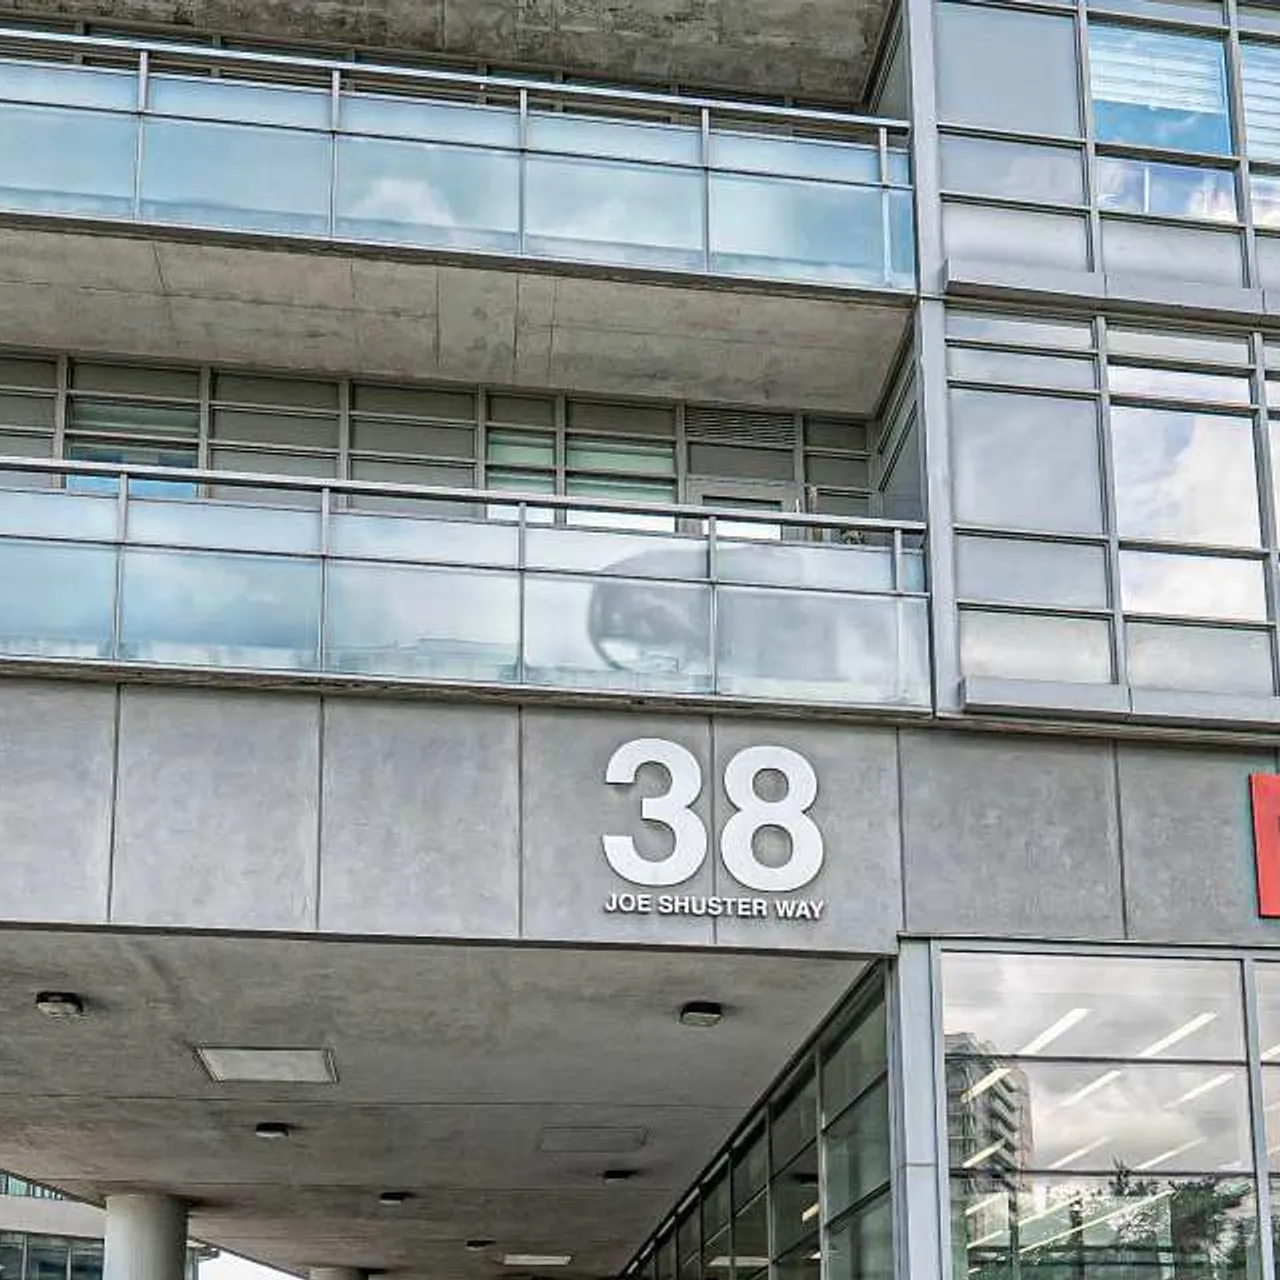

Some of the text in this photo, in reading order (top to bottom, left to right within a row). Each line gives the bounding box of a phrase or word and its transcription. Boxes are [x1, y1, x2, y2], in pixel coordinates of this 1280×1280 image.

[601, 738, 824, 892] 38
[604, 893, 824, 920] JOE SHUSTER WAY
